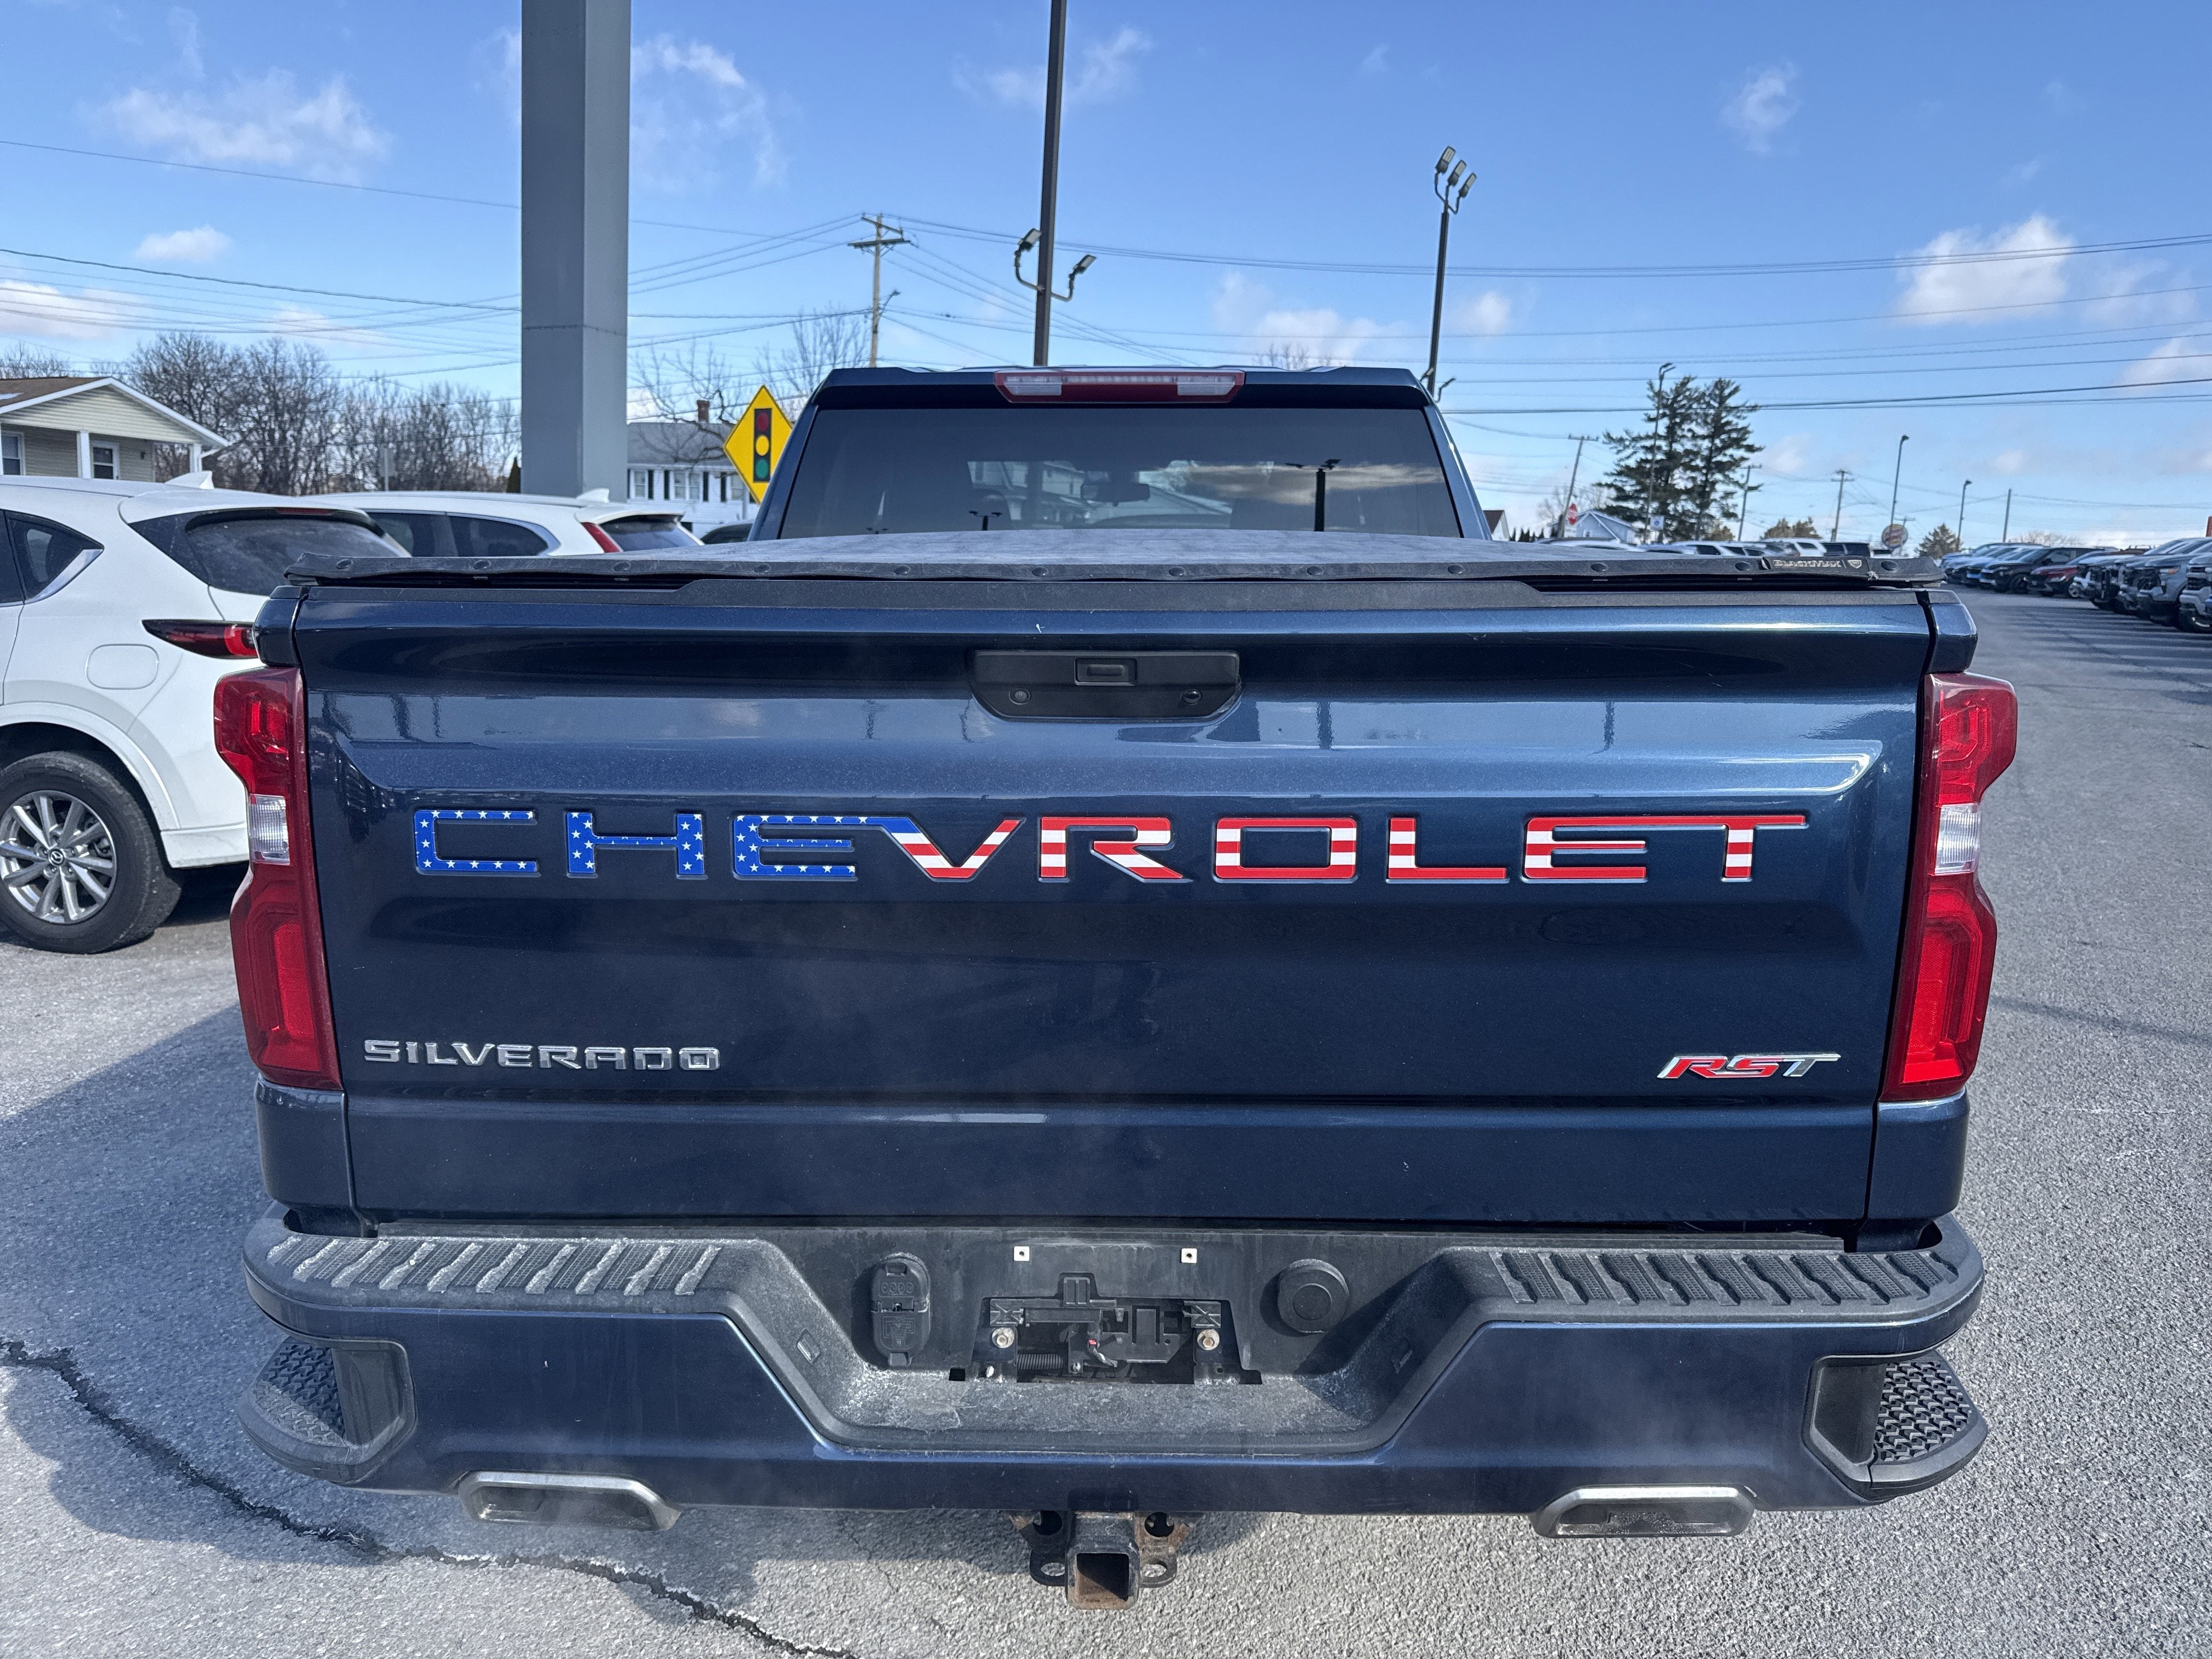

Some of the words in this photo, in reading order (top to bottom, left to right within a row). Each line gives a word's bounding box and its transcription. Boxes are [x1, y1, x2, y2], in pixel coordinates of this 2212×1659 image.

[414, 809, 1807, 884] CHEVROLET
[364, 1040, 720, 1070] SILVERADO
[1656, 1054, 1841, 1079] RST
